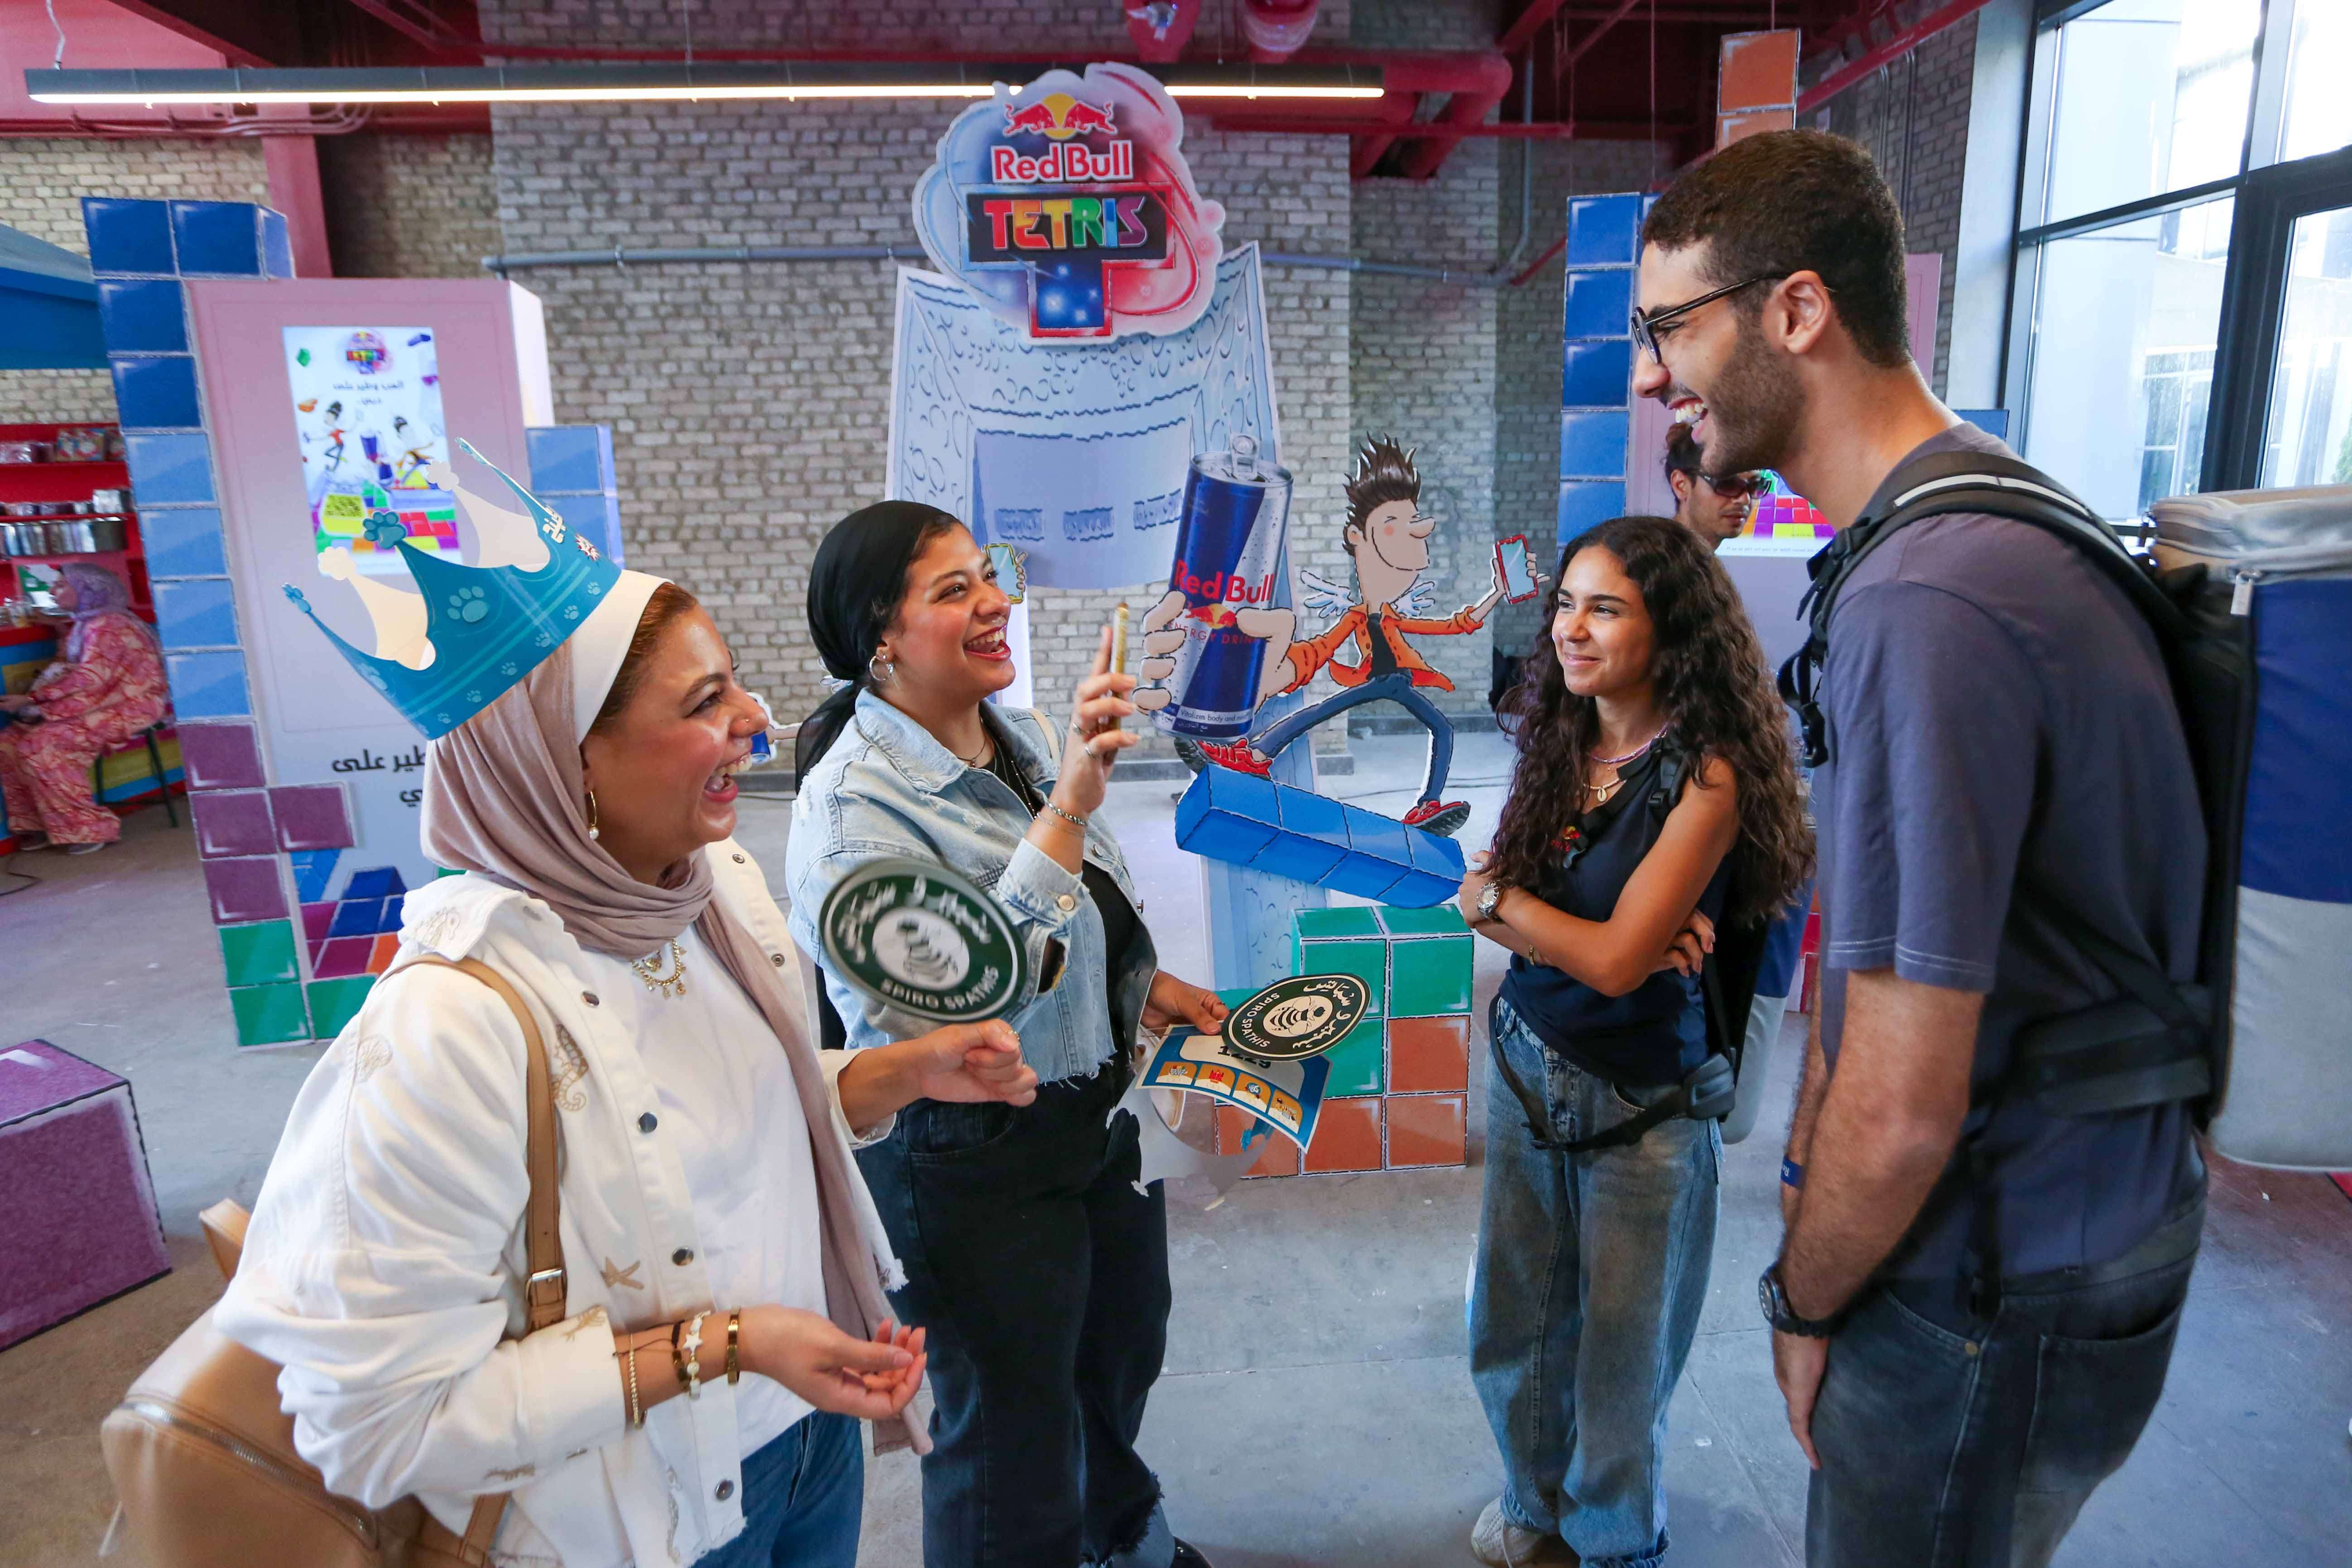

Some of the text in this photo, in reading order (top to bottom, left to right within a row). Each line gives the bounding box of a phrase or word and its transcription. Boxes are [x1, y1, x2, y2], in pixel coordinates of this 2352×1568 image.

[992, 141, 1132, 182] Red Bull
[984, 197, 1147, 249] TETRIS
[1174, 559, 1275, 603] Red Bull
[1222, 634, 1254, 644] DRIN
[1208, 714, 1223, 723] body
[331, 749, 386, 772] على
[1246, 993, 1280, 1017] SPIRO
[1241, 1018, 1271, 1048] SPATHIS
